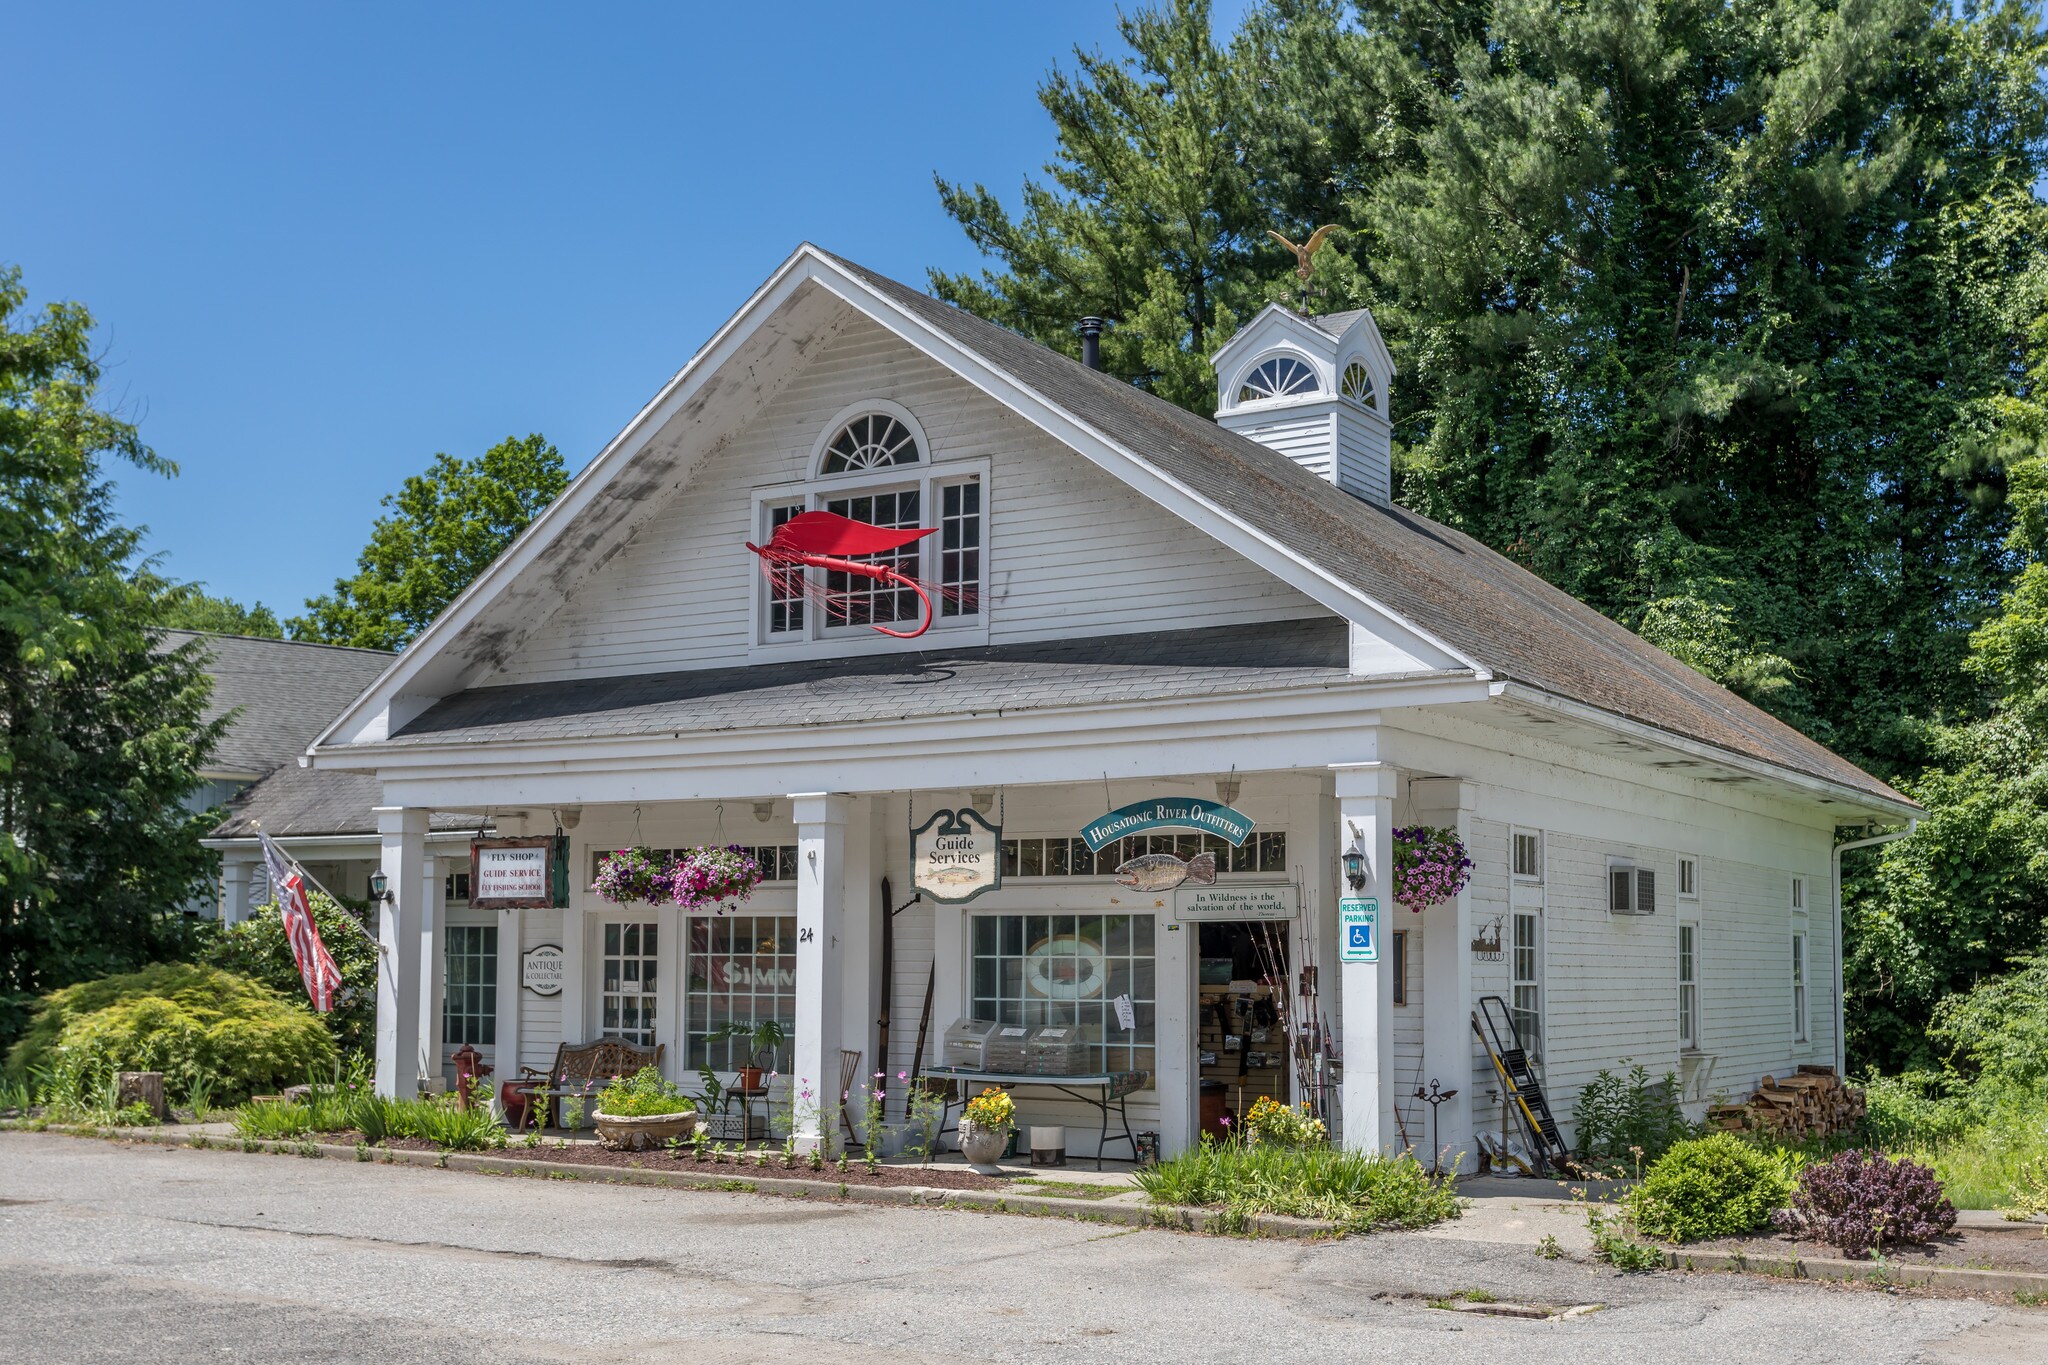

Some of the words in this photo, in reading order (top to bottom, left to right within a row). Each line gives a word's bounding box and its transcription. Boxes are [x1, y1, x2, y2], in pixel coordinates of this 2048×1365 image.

[1089, 811, 1153, 843] HOUSATONIC
[1156, 805, 1187, 820] RIVER
[1191, 804, 1244, 838] OUTFITTERS
[935, 837, 974, 850] Guide
[491, 853, 507, 861] FLY
[509, 853, 534, 861] SHOP
[929, 851, 981, 864] Services
[483, 869, 507, 877] GUIDE
[509, 868, 541, 877] SERVICE
[1196, 894, 1206, 902] In
[1209, 893, 1247, 902] Wildness
[1250, 892, 1258, 901] is
[1261, 892, 1275, 901] the
[1187, 903, 1224, 912] salvation
[1227, 902, 1237, 911] of
[1240, 902, 1254, 911] the
[1257, 902, 1285, 910] world.
[1342, 903, 1376, 911] RESERVED
[800, 927, 813, 943] 24
[527, 961, 563, 971] ANTIQUE
